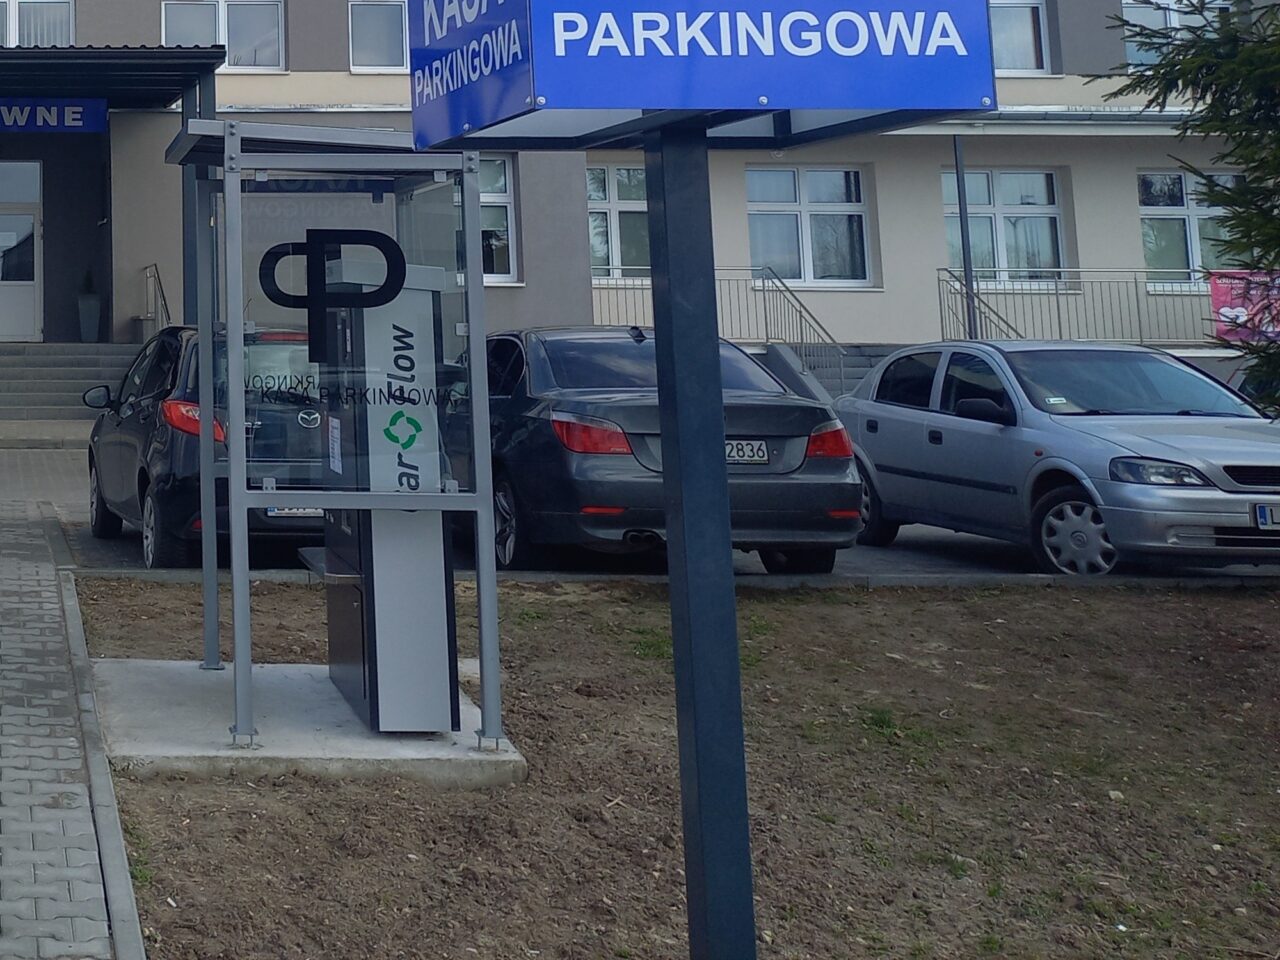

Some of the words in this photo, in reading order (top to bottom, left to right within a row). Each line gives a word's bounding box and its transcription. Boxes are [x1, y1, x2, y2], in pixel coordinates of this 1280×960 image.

[553, 11, 967, 56] PARKINGOWA
[414, 19, 522, 107] PARKINGOWA
[261, 387, 312, 405] KASA
[320, 387, 455, 407] PARKINGOWA
[397, 452, 421, 511] ar
